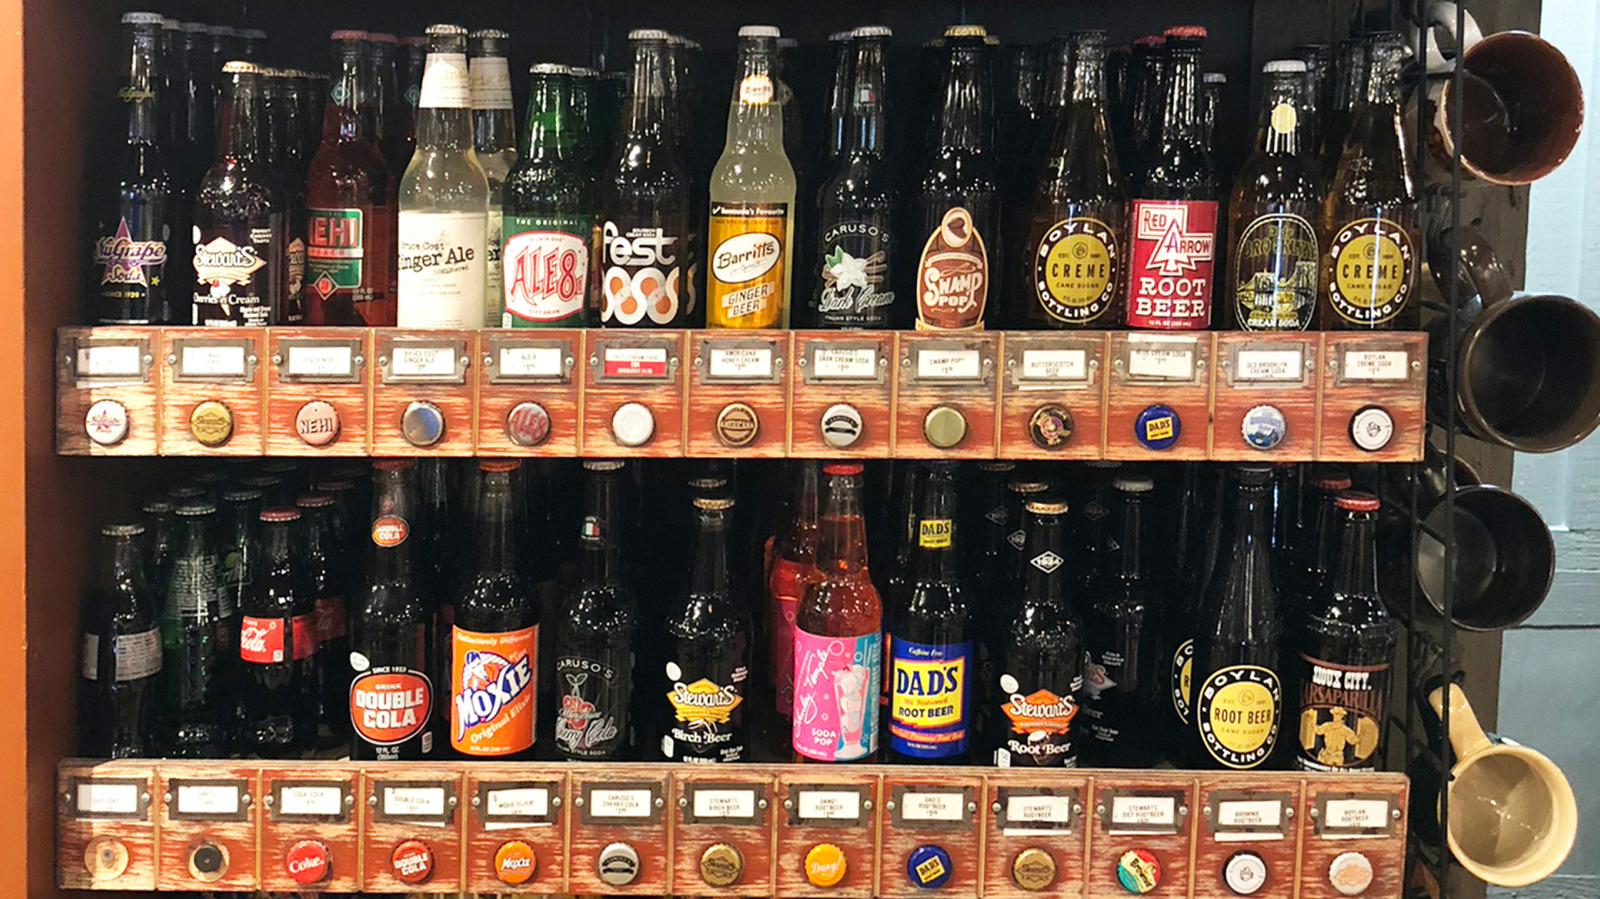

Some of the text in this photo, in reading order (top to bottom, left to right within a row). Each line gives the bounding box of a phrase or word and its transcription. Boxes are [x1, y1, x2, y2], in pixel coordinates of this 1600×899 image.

[516, 218, 578, 226] THE ORIGINAL
[1143, 210, 1167, 232] RED
[824, 223, 890, 243] CARUSO'S
[1039, 221, 1116, 258] BOYLAN
[1164, 233, 1211, 253] ARROW
[1331, 223, 1411, 260] BOYLAN
[603, 221, 678, 266] fest
[398, 251, 443, 272] inger
[446, 246, 475, 266] Ale
[1051, 263, 1105, 278] CREME
[1342, 264, 1399, 280] CREME
[728, 284, 770, 306] GINGER
[923, 267, 983, 313] SWAMP
[1138, 277, 1206, 296] ROOT
[732, 299, 761, 317] BEER
[939, 295, 968, 307] POP
[1037, 281, 1100, 318] BOTTLING
[1135, 297, 1206, 317] BEER
[1329, 281, 1392, 319] BOTTLING
[854, 356, 869, 364] SODA
[1031, 360, 1075, 368] BUTTERSCOTCH
[300, 418, 333, 434] NEHI
[556, 658, 614, 679] CARUSO'S
[1312, 665, 1342, 688] SIOUX
[896, 666, 957, 696] DAD'S
[1204, 670, 1279, 700] BOYLAN
[356, 687, 424, 710] DOUBLE
[456, 655, 531, 742] MOXIE
[363, 708, 417, 728] COLA
[470, 714, 511, 744] Original
[510, 693, 532, 719] Elixir
[898, 705, 954, 718] ROOT BEER
[1214, 707, 1272, 725] ROOT BEER
[671, 728, 733, 744] Birch Beer
[811, 728, 836, 738] SODA
[814, 737, 833, 746] POP
[1202, 722, 1265, 763] BOTTLING
[1007, 739, 1071, 755] Root Beer
[289, 856, 322, 873] Coke
[393, 852, 429, 870] DOUBLE
[401, 863, 427, 876] COLA
[811, 855, 842, 875] Dang!
